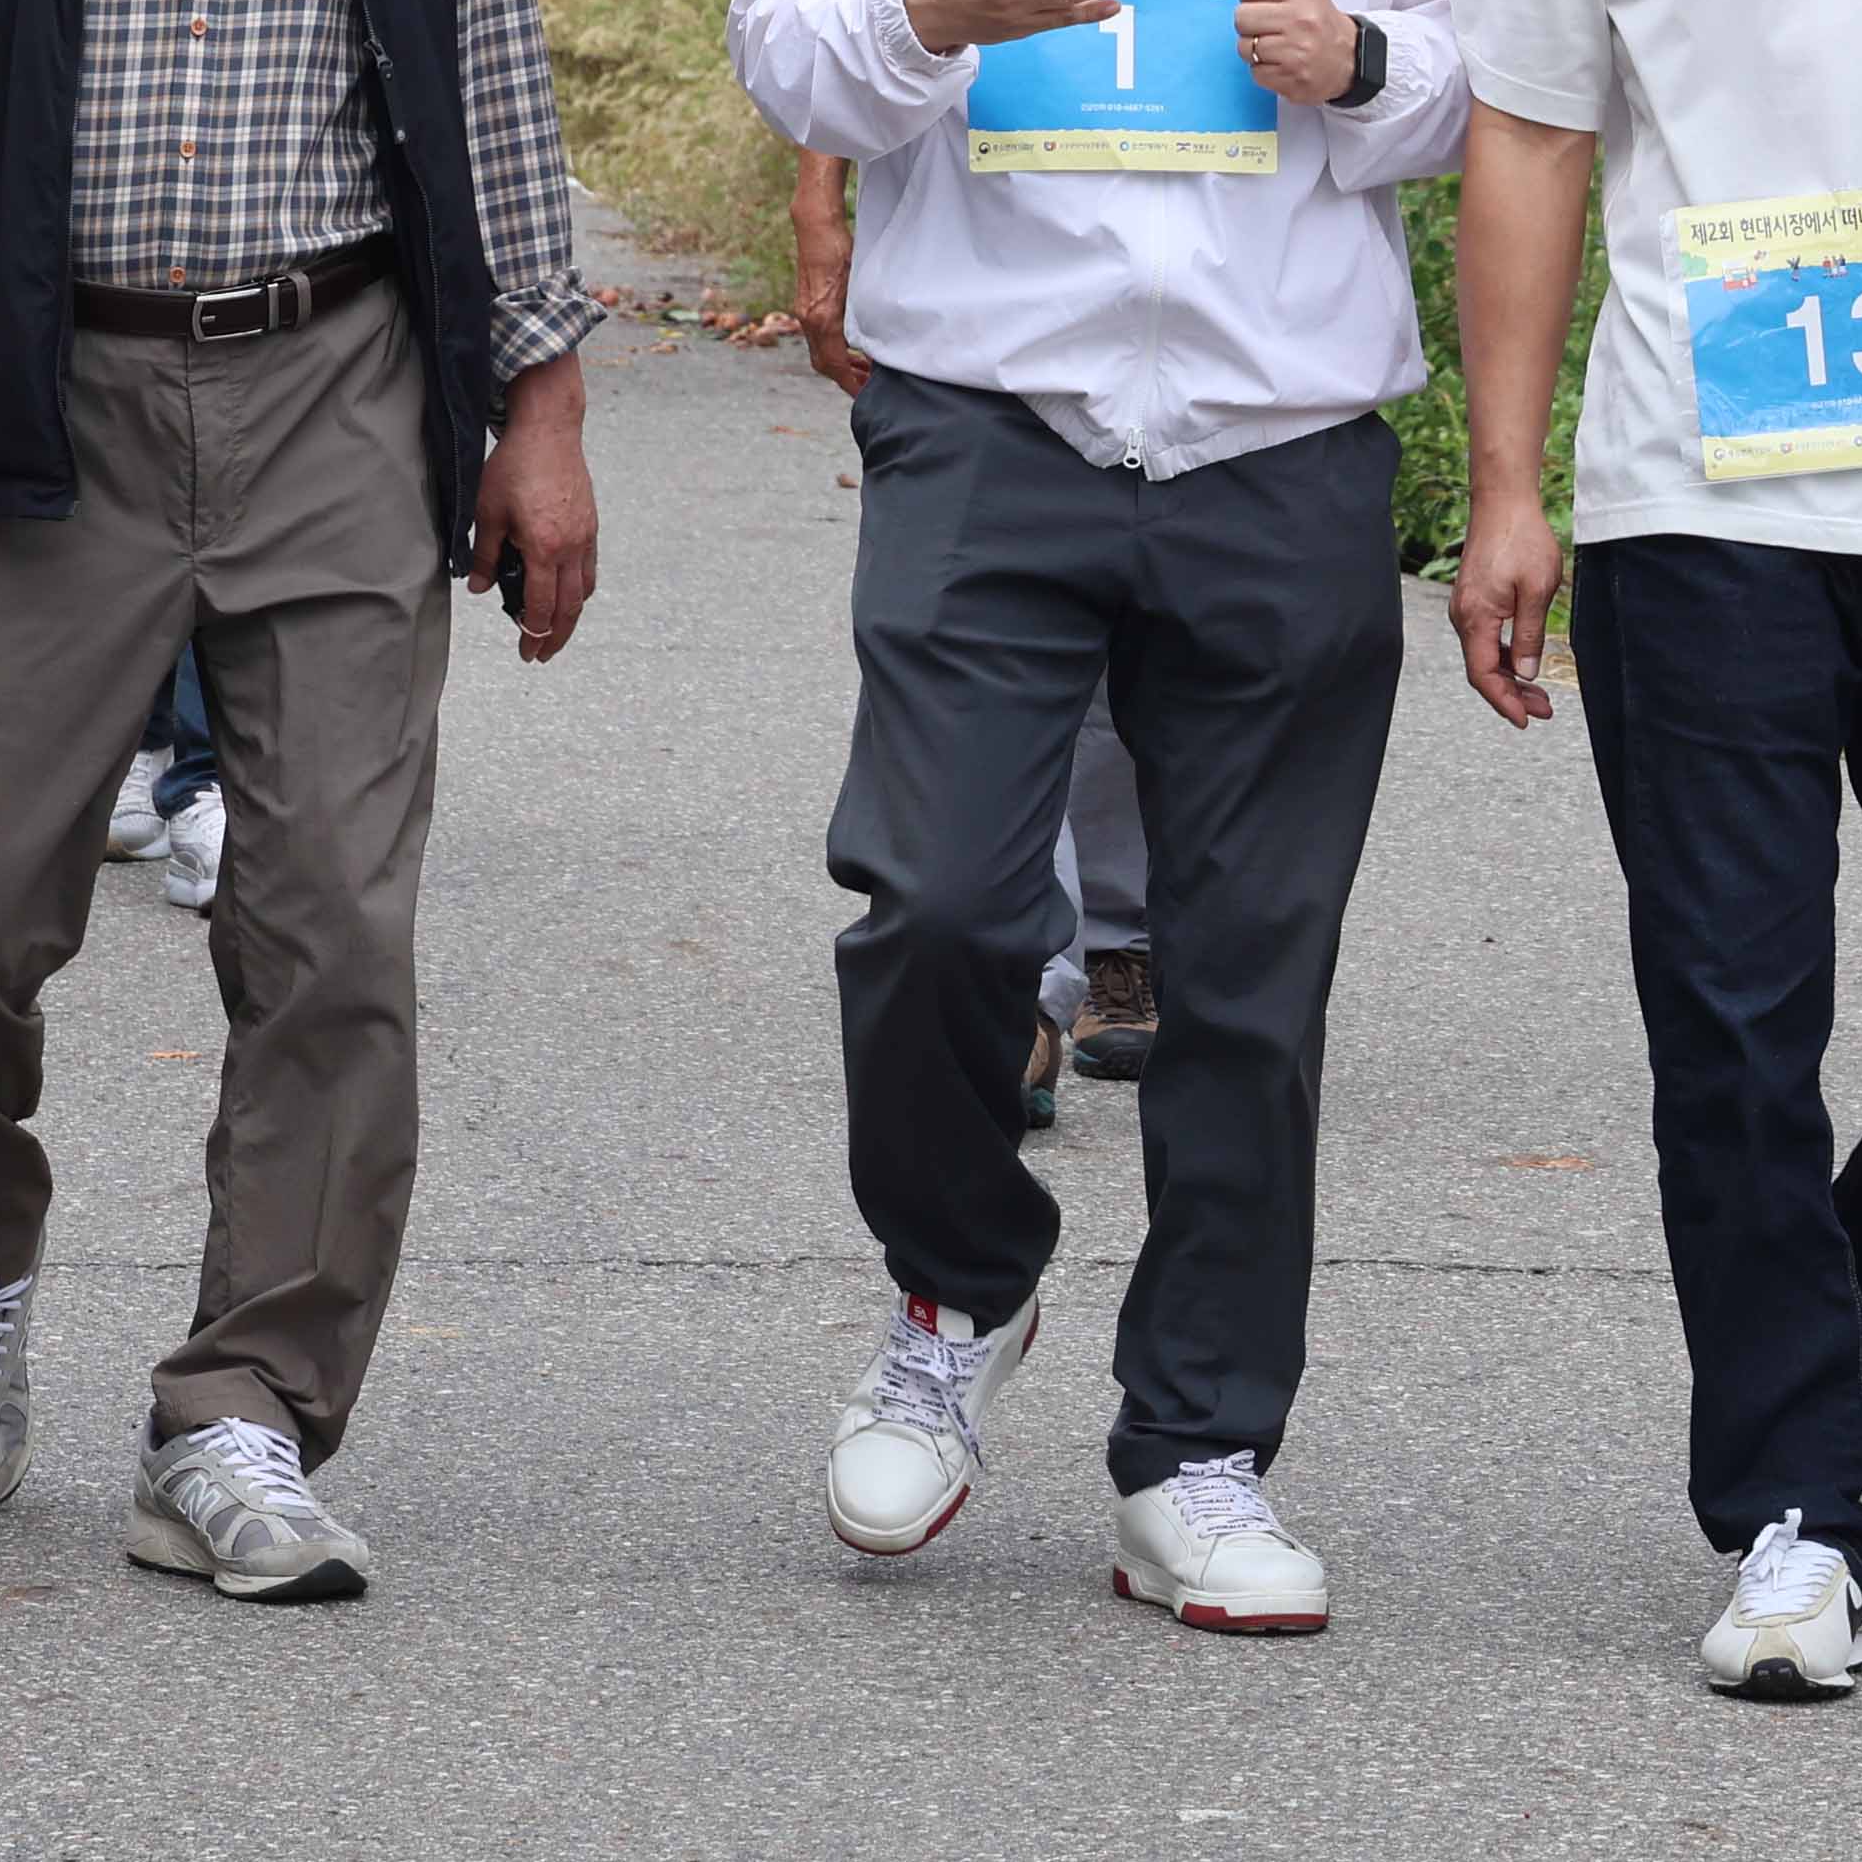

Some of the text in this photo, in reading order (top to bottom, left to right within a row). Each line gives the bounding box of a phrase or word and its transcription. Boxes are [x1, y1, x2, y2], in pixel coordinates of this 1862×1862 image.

[1098, 4, 1135, 90] 1
[1690, 219, 1734, 246] 제2회
[1740, 211, 1838, 241] 현대시장에서
